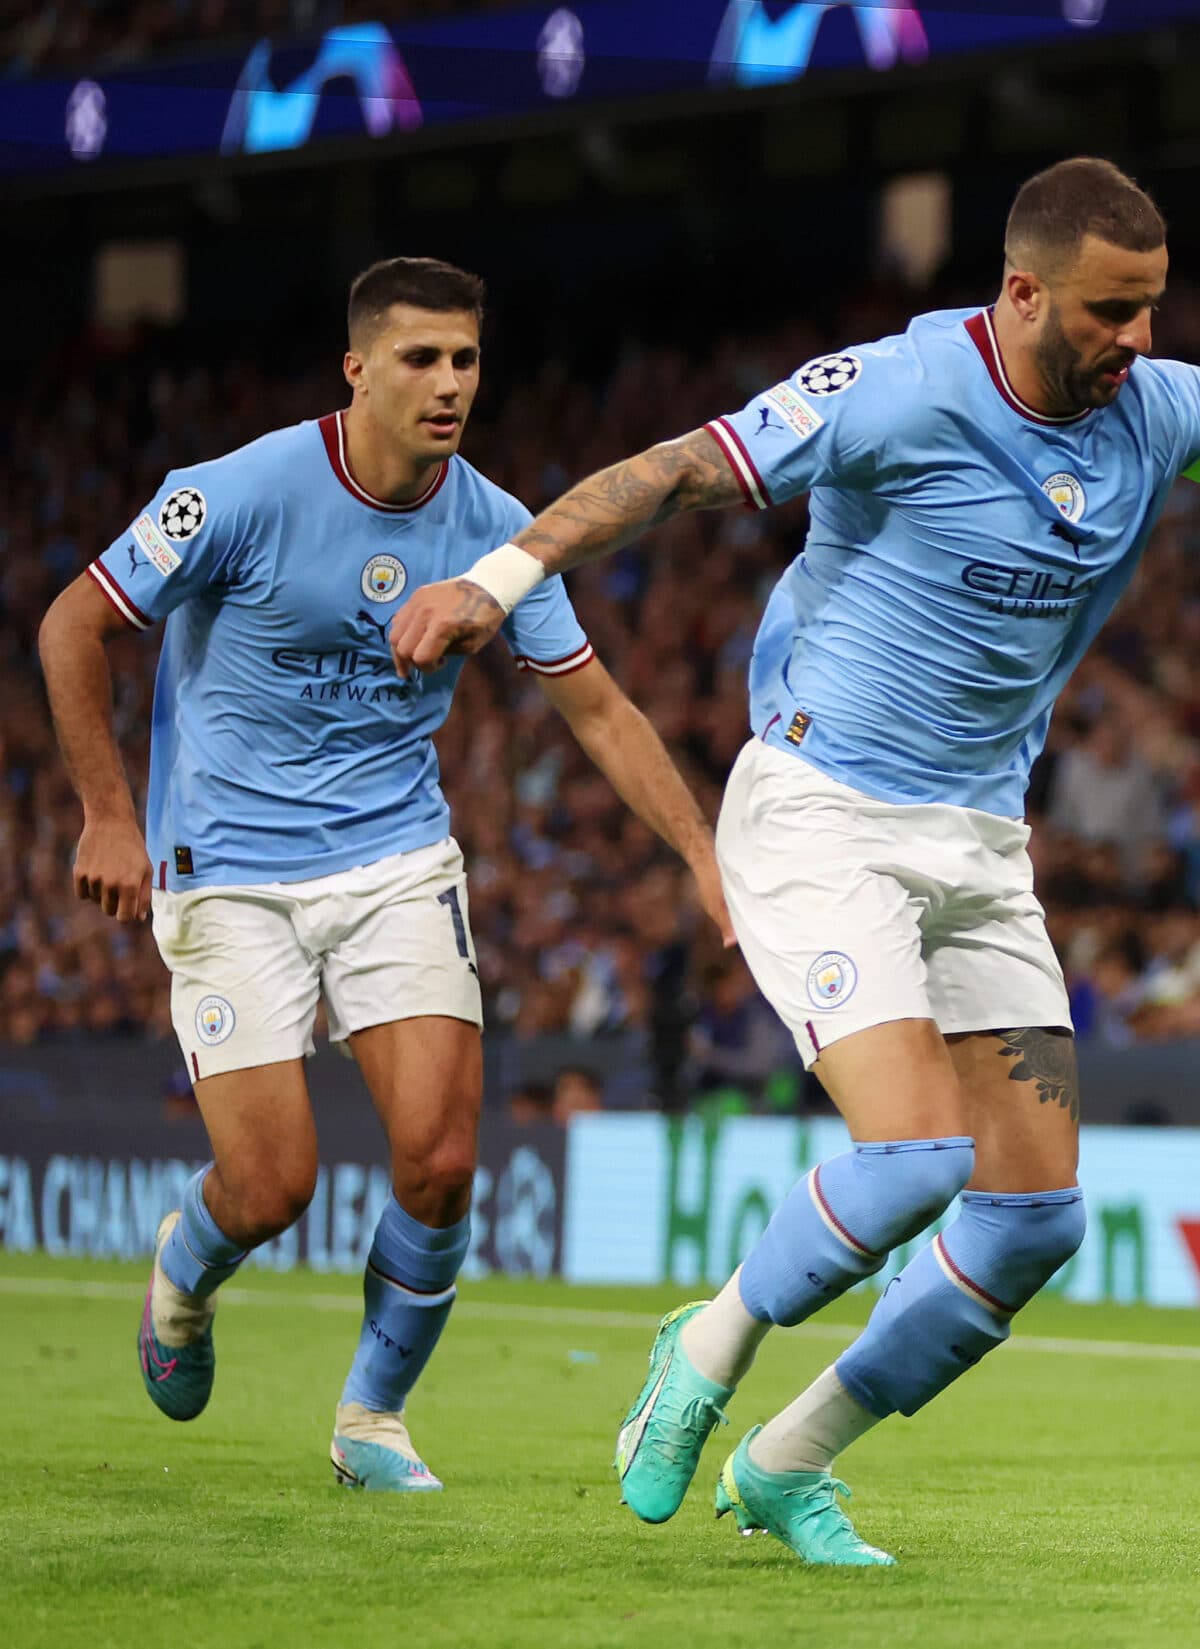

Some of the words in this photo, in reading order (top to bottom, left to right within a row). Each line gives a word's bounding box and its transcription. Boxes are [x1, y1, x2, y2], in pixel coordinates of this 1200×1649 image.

[961, 561, 1096, 601] ETIH
[437, 886, 469, 958] 1
[370, 1319, 413, 1359] CITY
